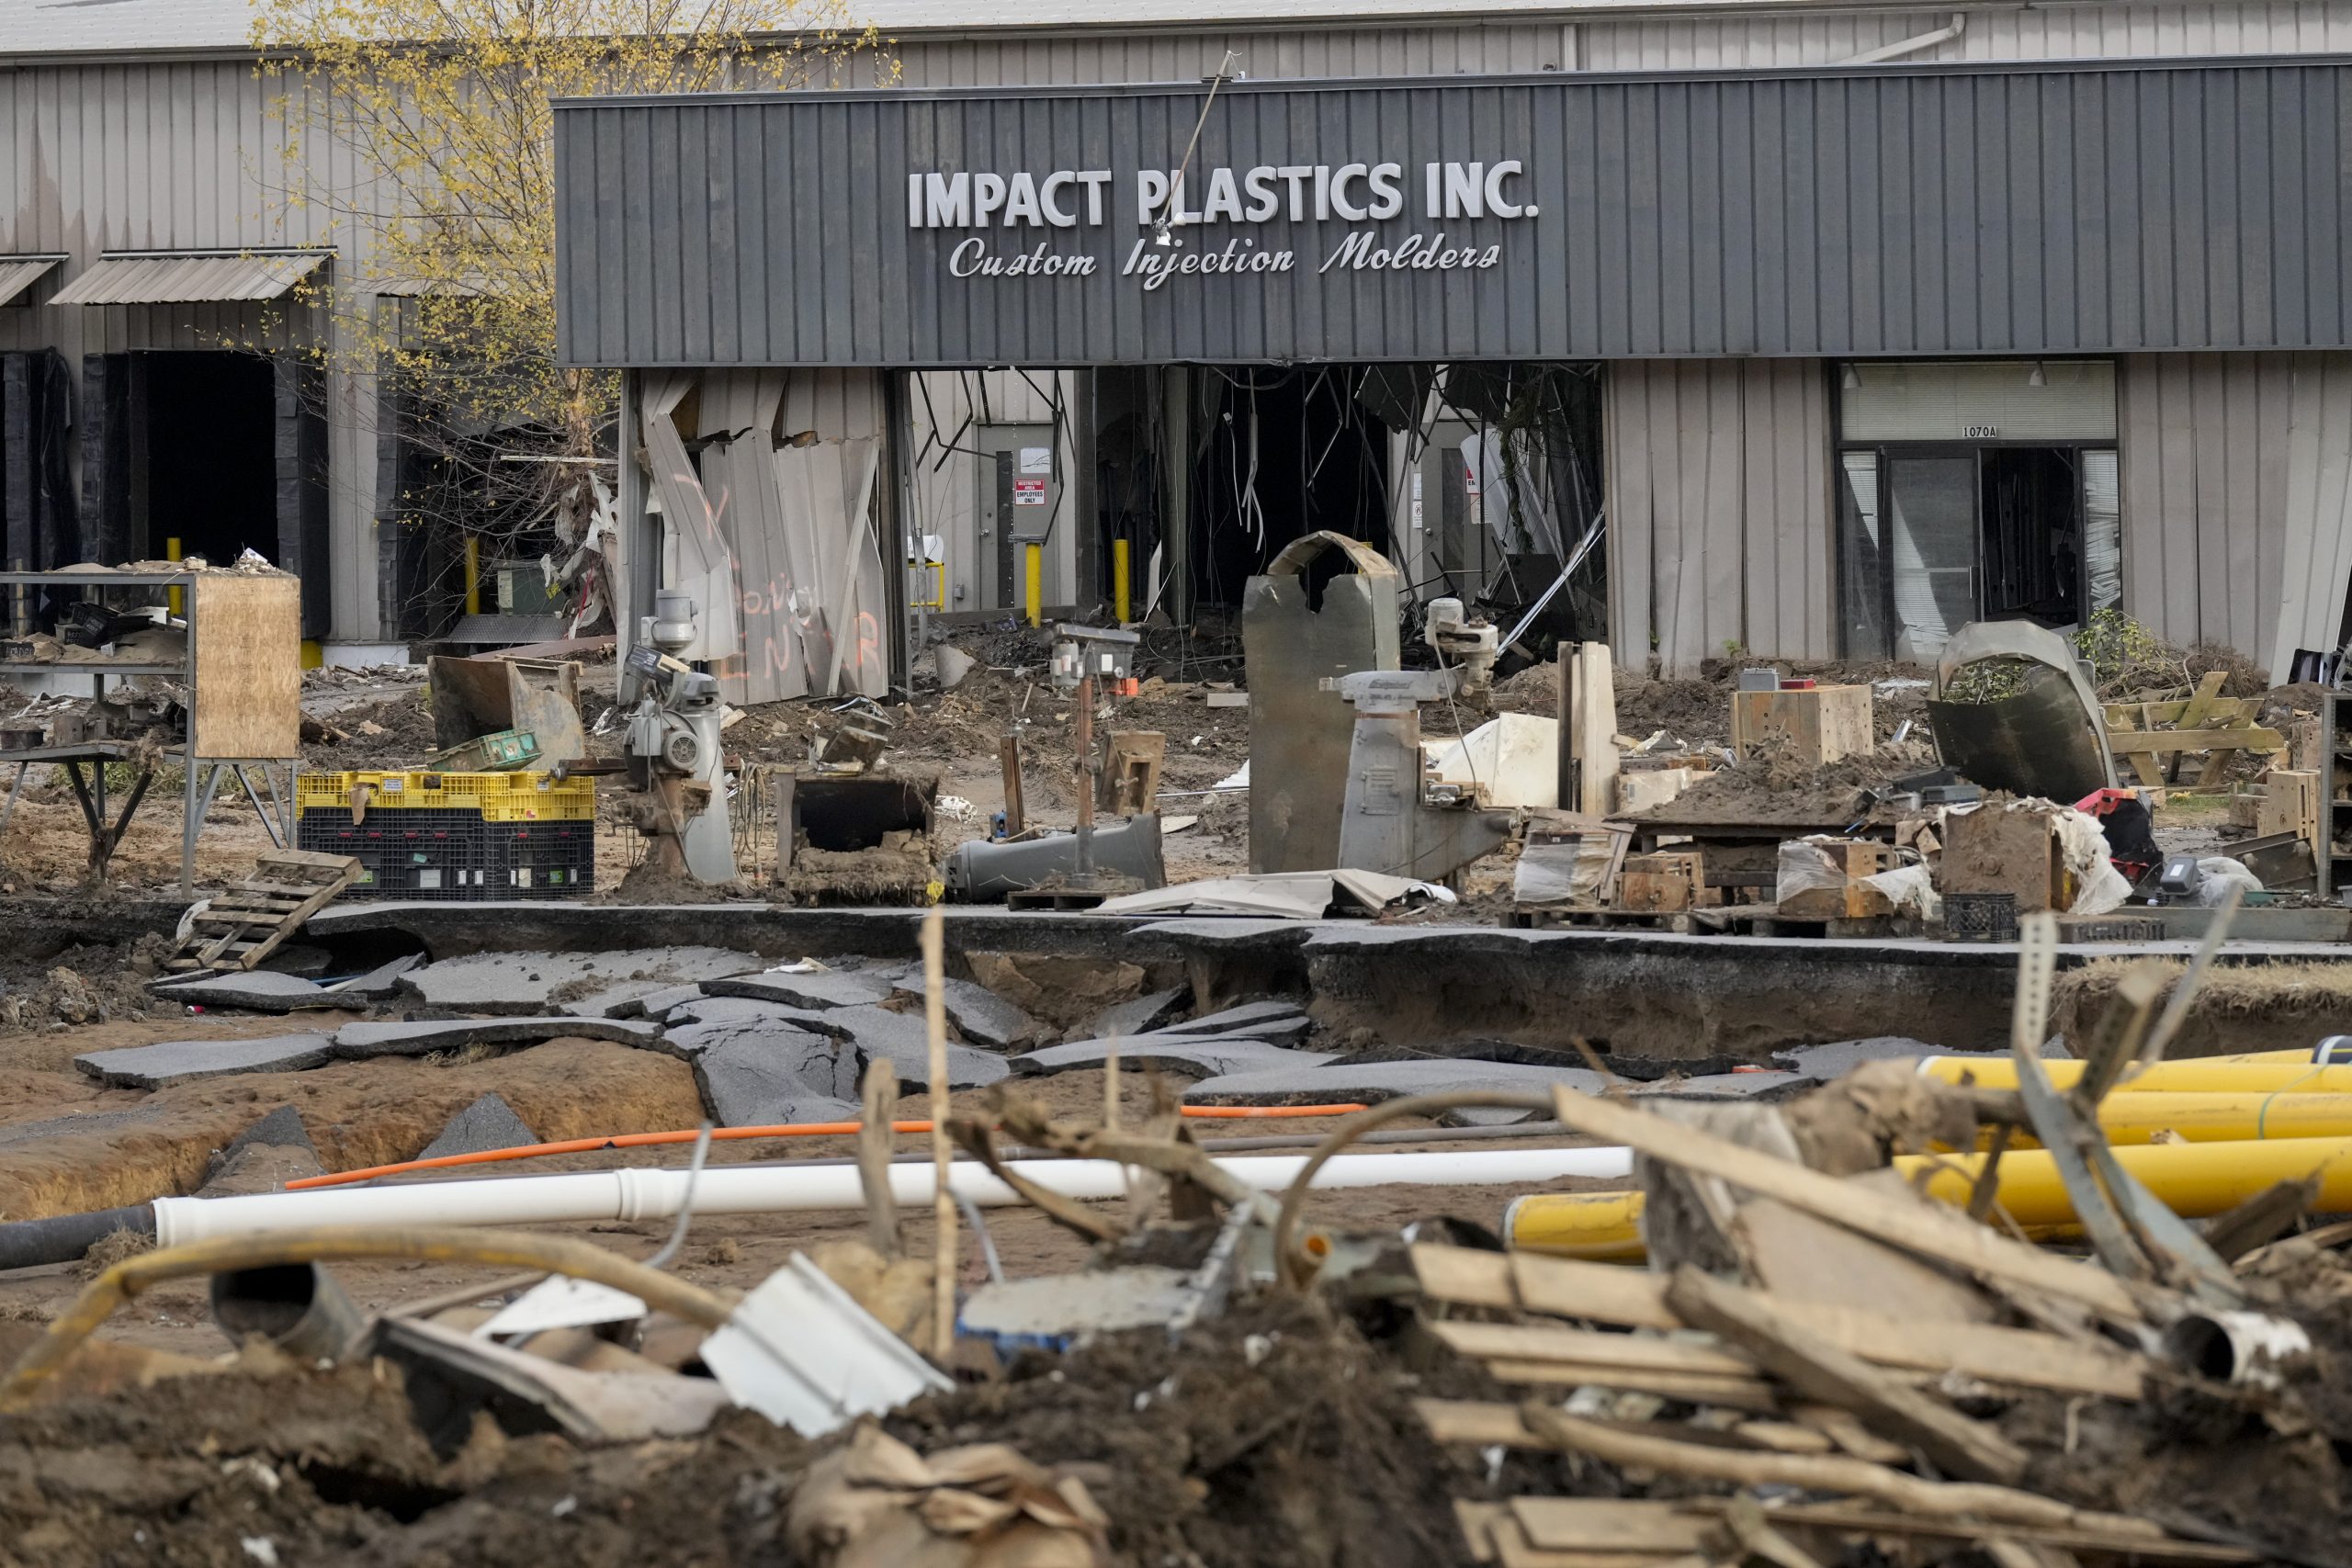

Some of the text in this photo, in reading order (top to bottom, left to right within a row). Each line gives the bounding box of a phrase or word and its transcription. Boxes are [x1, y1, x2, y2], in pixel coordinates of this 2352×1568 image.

[909, 160, 1539, 228] IMPACT PLASTICS INC.
[949, 231, 1501, 291] Custom Injection Molders
[1963, 426, 1996, 437] 1070A
